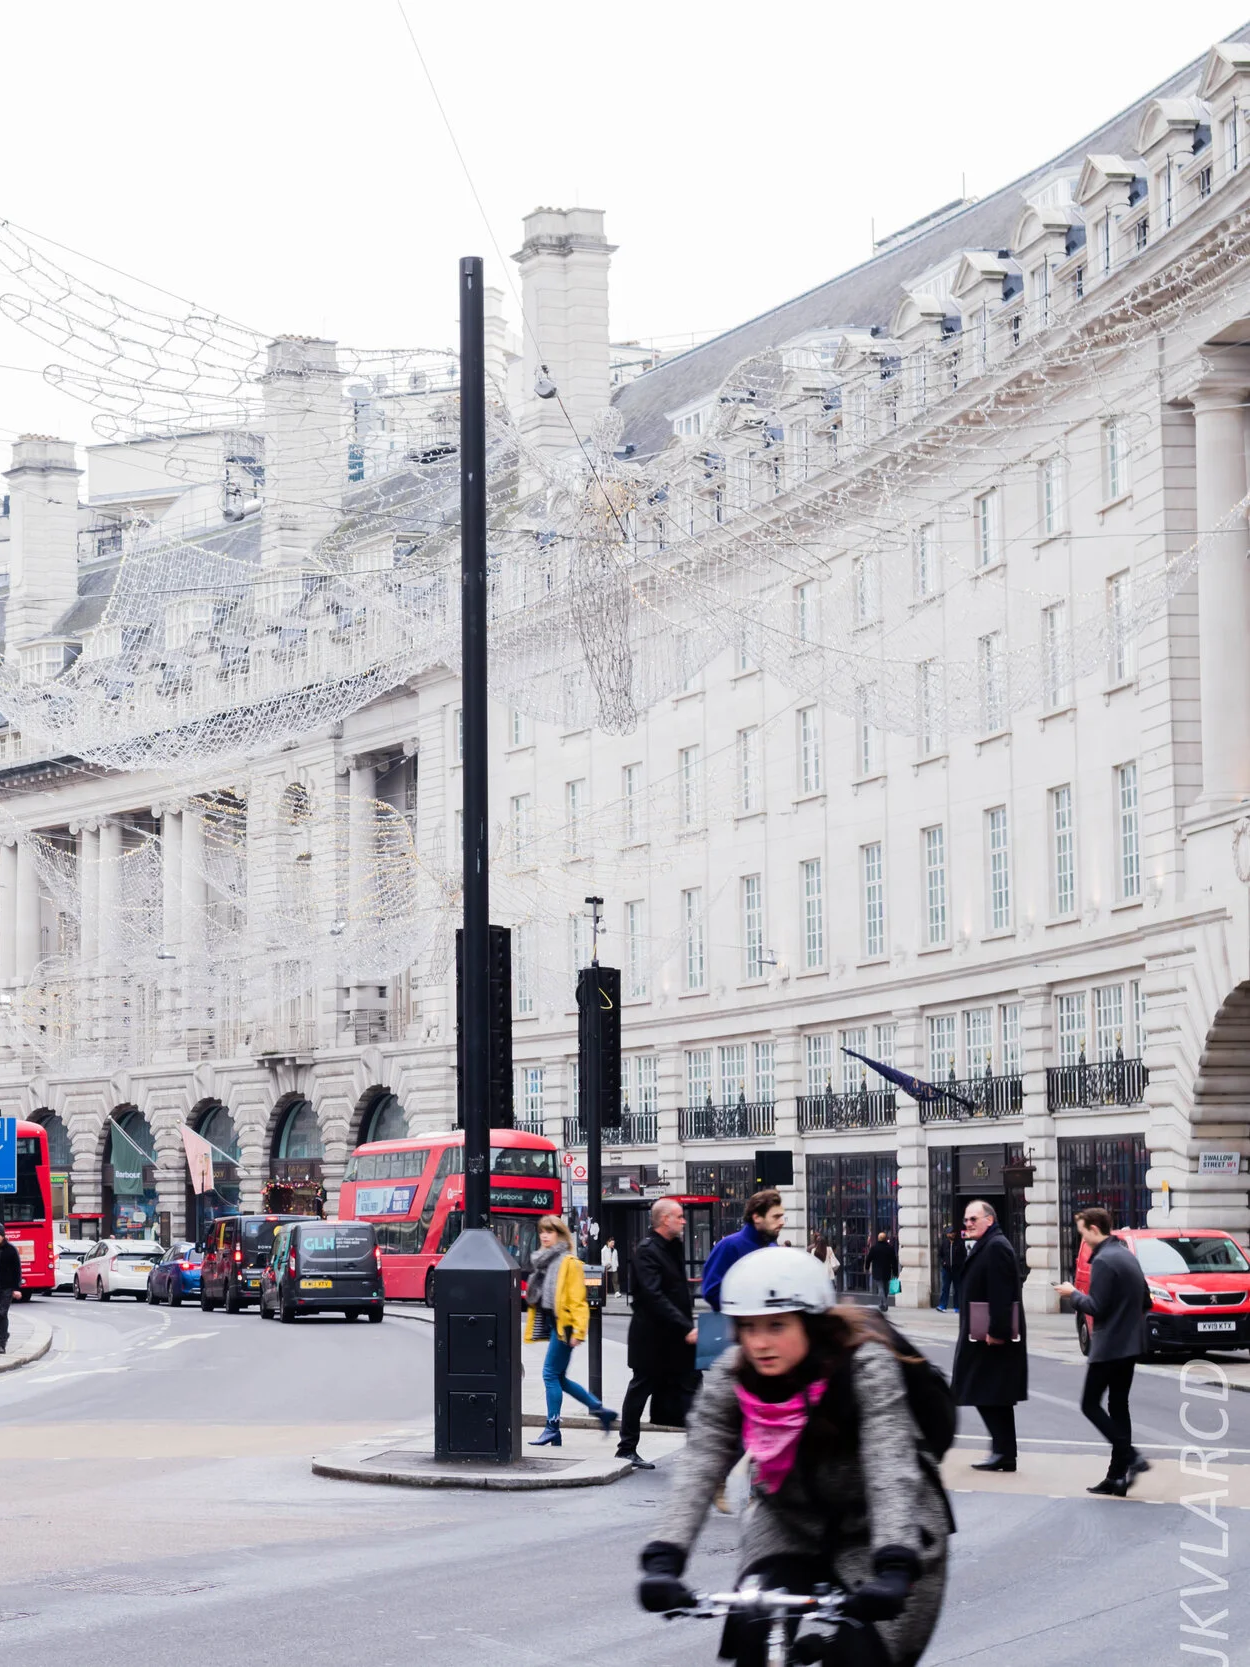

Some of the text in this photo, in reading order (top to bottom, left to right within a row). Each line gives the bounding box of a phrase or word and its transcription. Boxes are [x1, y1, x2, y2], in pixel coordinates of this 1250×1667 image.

[115, 1170, 141, 1178] Barbour
[490, 1192, 548, 1205] arylebone 453
[303, 1237, 334, 1250] GLH
